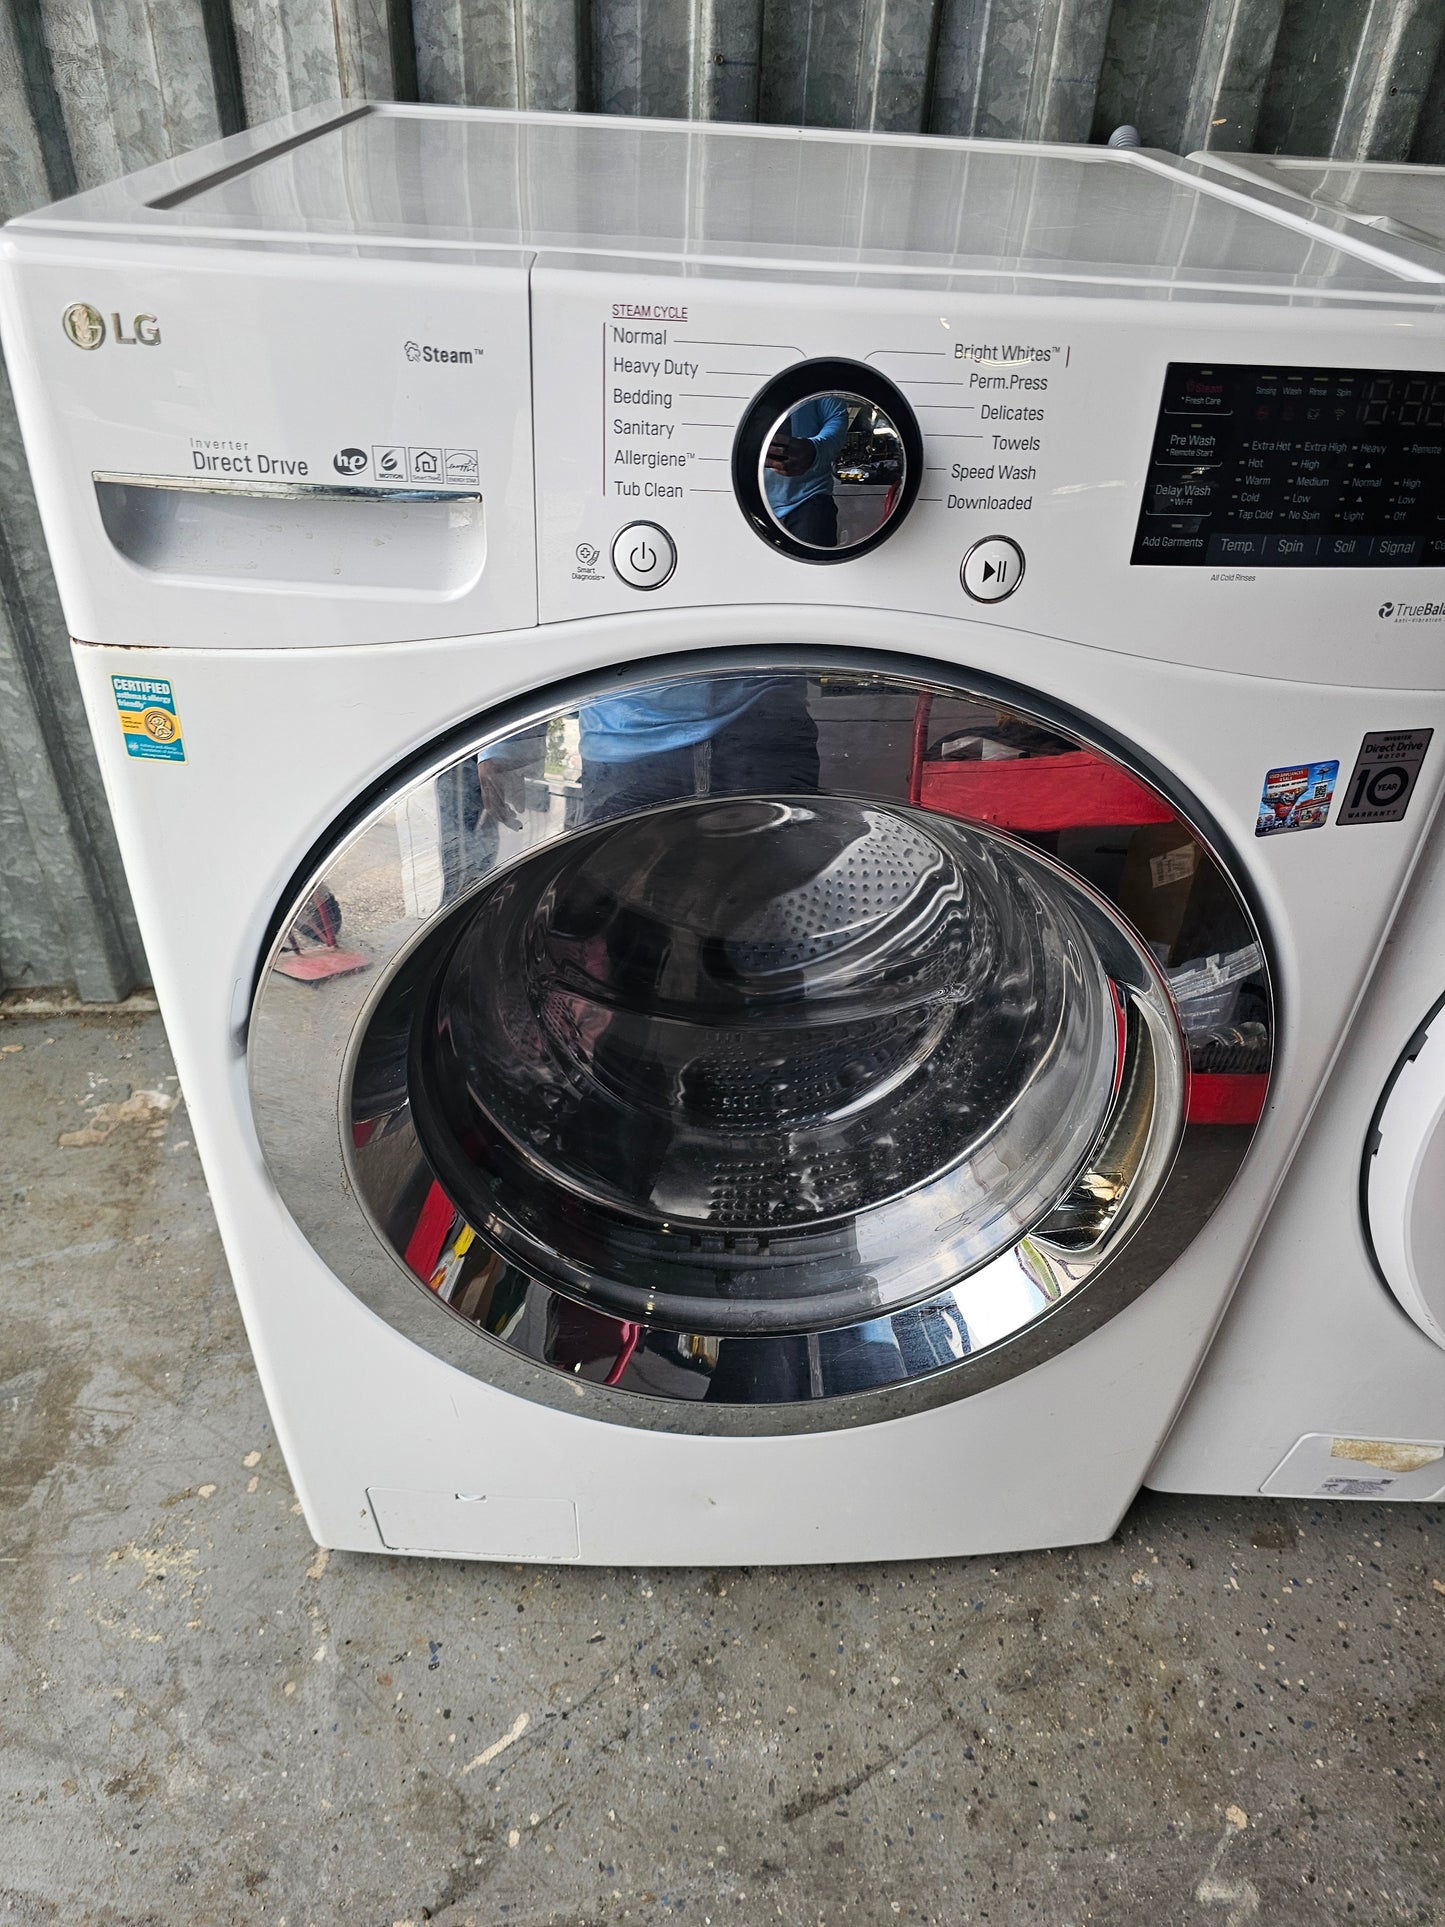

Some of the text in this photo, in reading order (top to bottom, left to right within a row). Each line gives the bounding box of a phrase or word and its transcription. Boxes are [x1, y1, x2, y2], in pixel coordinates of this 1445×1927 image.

[612, 304, 688, 319] STEAM CYCLE
[111, 312, 161, 346] LG
[613, 327, 667, 345] Normal
[954, 344, 998, 363] Bright
[614, 356, 698, 379] Heavy Duty
[970, 373, 1048, 390] Perm.Press
[1283, 387, 1302, 396] Wash
[1309, 387, 1327, 396] Rinse
[1336, 388, 1352, 397] Spin
[614, 388, 672, 409] Bedding
[981, 404, 1045, 420] Delicates
[614, 418, 674, 439] Sanitary
[189, 437, 249, 451] Inverter
[992, 435, 1040, 450] Towels
[1170, 434, 1216, 446] Pre Wash
[1251, 441, 1291, 451] Extra Hot
[1196, 448, 1213, 457] Start
[1304, 441, 1347, 454] Extra High
[1360, 443, 1387, 455] Heavy
[192, 450, 309, 476] Direct Drive
[1248, 459, 1264, 468] Hot
[1301, 459, 1320, 471] High
[951, 464, 1036, 481] Speed Wash
[1245, 475, 1271, 485] Warm
[1296, 477, 1329, 486] Medium
[1352, 478, 1382, 487] Normal
[1402, 479, 1421, 489] High
[614, 481, 683, 497] Tub Clean
[1155, 485, 1211, 497] Delay Wash
[947, 494, 1033, 510] Downloaded
[1241, 493, 1260, 502] Cold
[1293, 494, 1311, 503] Low
[1398, 496, 1416, 504] Low
[1238, 510, 1273, 520] Tap Cold
[1288, 510, 1320, 521] No Spin
[1344, 511, 1364, 522] Light
[1394, 512, 1407, 520] Off
[1142, 536, 1203, 548] Add Garments
[1221, 538, 1255, 554] Temp.
[1278, 540, 1304, 555] Spin
[1334, 540, 1356, 553] Soil
[1379, 541, 1415, 556] Signal
[1235, 574, 1256, 582] Rinses
[113, 678, 170, 694] CERTIFIED
[1365, 741, 1423, 753] Direct Drive
[1351, 766, 1409, 808] 10
[1377, 783, 1398, 791] YEAR
[1348, 810, 1397, 818] WARRANTY
